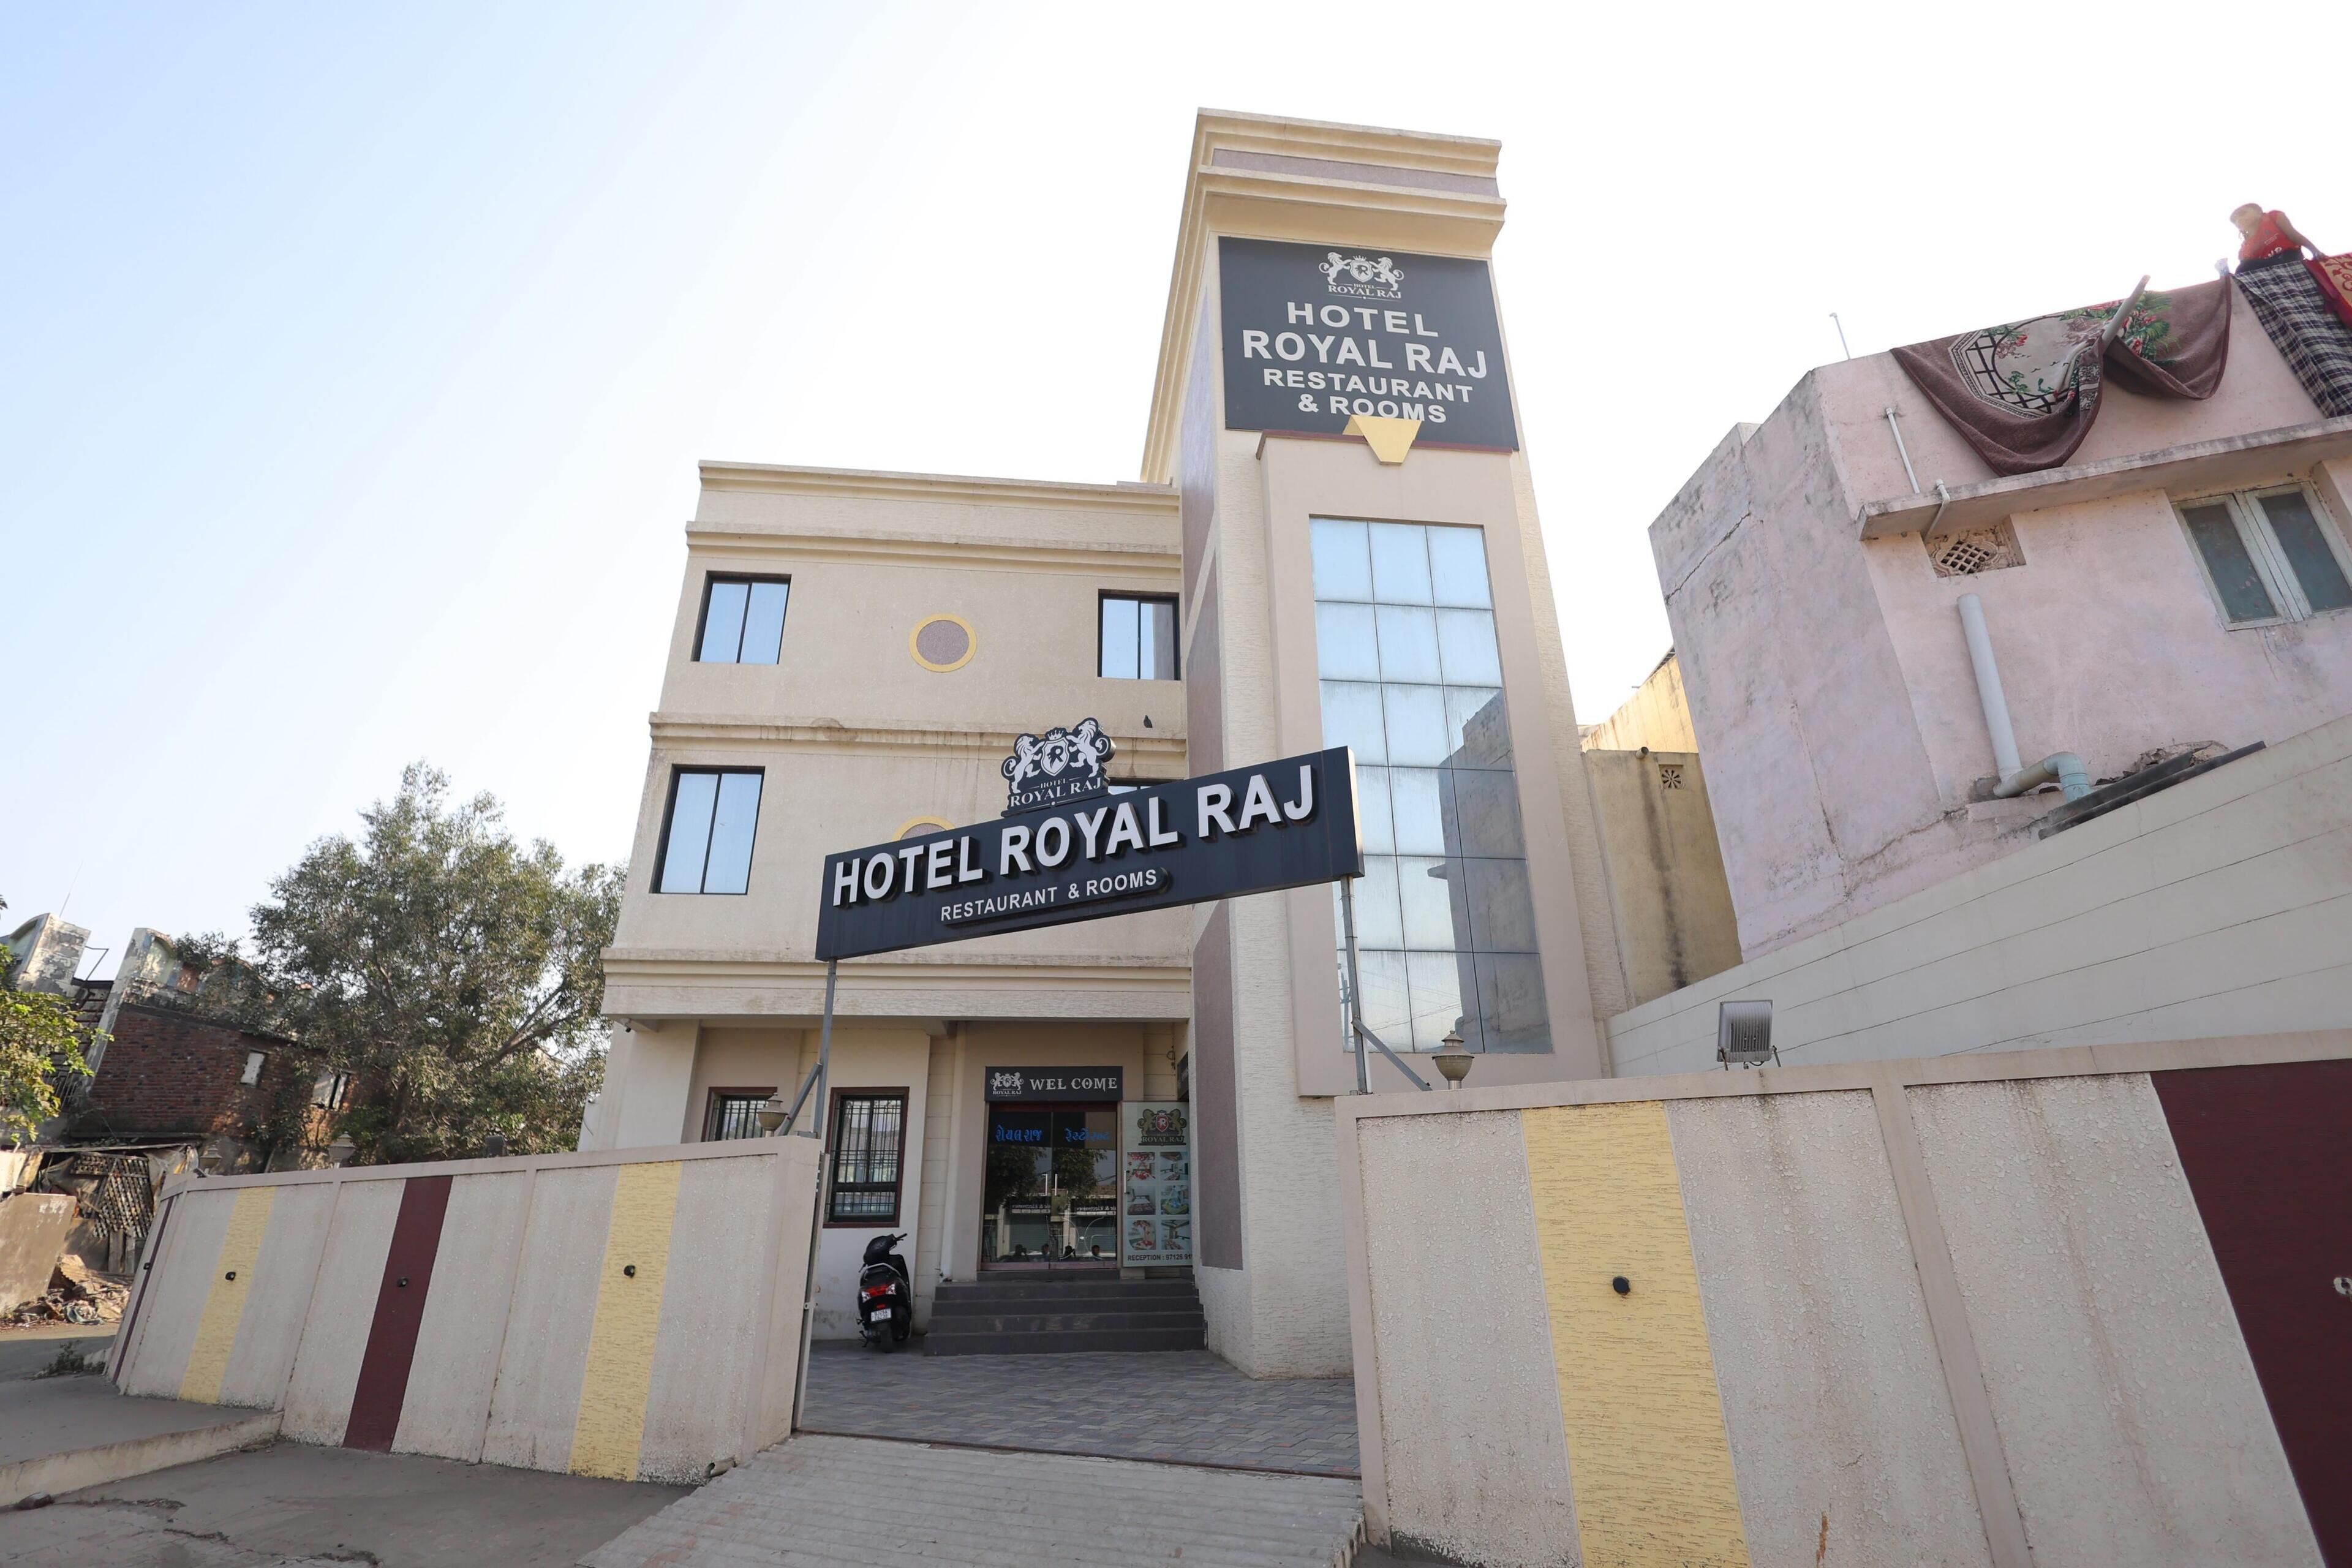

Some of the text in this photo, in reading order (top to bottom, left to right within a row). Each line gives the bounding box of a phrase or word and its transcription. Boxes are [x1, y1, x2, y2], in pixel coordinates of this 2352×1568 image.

[1328, 285, 1401, 299] ROYAL RAJ
[1287, 301, 1438, 337] HOTEL
[1242, 329, 1487, 379] ROYAL RAJ
[1264, 368, 1473, 402] RESTAURANT
[1298, 393, 1446, 423] & ROOMS
[1011, 777, 1101, 807] ROYAL RAJ
[1040, 778, 1068, 788] HOTEL
[832, 764, 1313, 907] HOTEL ROYAL RAJ
[941, 869, 1157, 922] RESTAURANT & ROOMS
[1030, 1077, 1117, 1092] WEL COME
